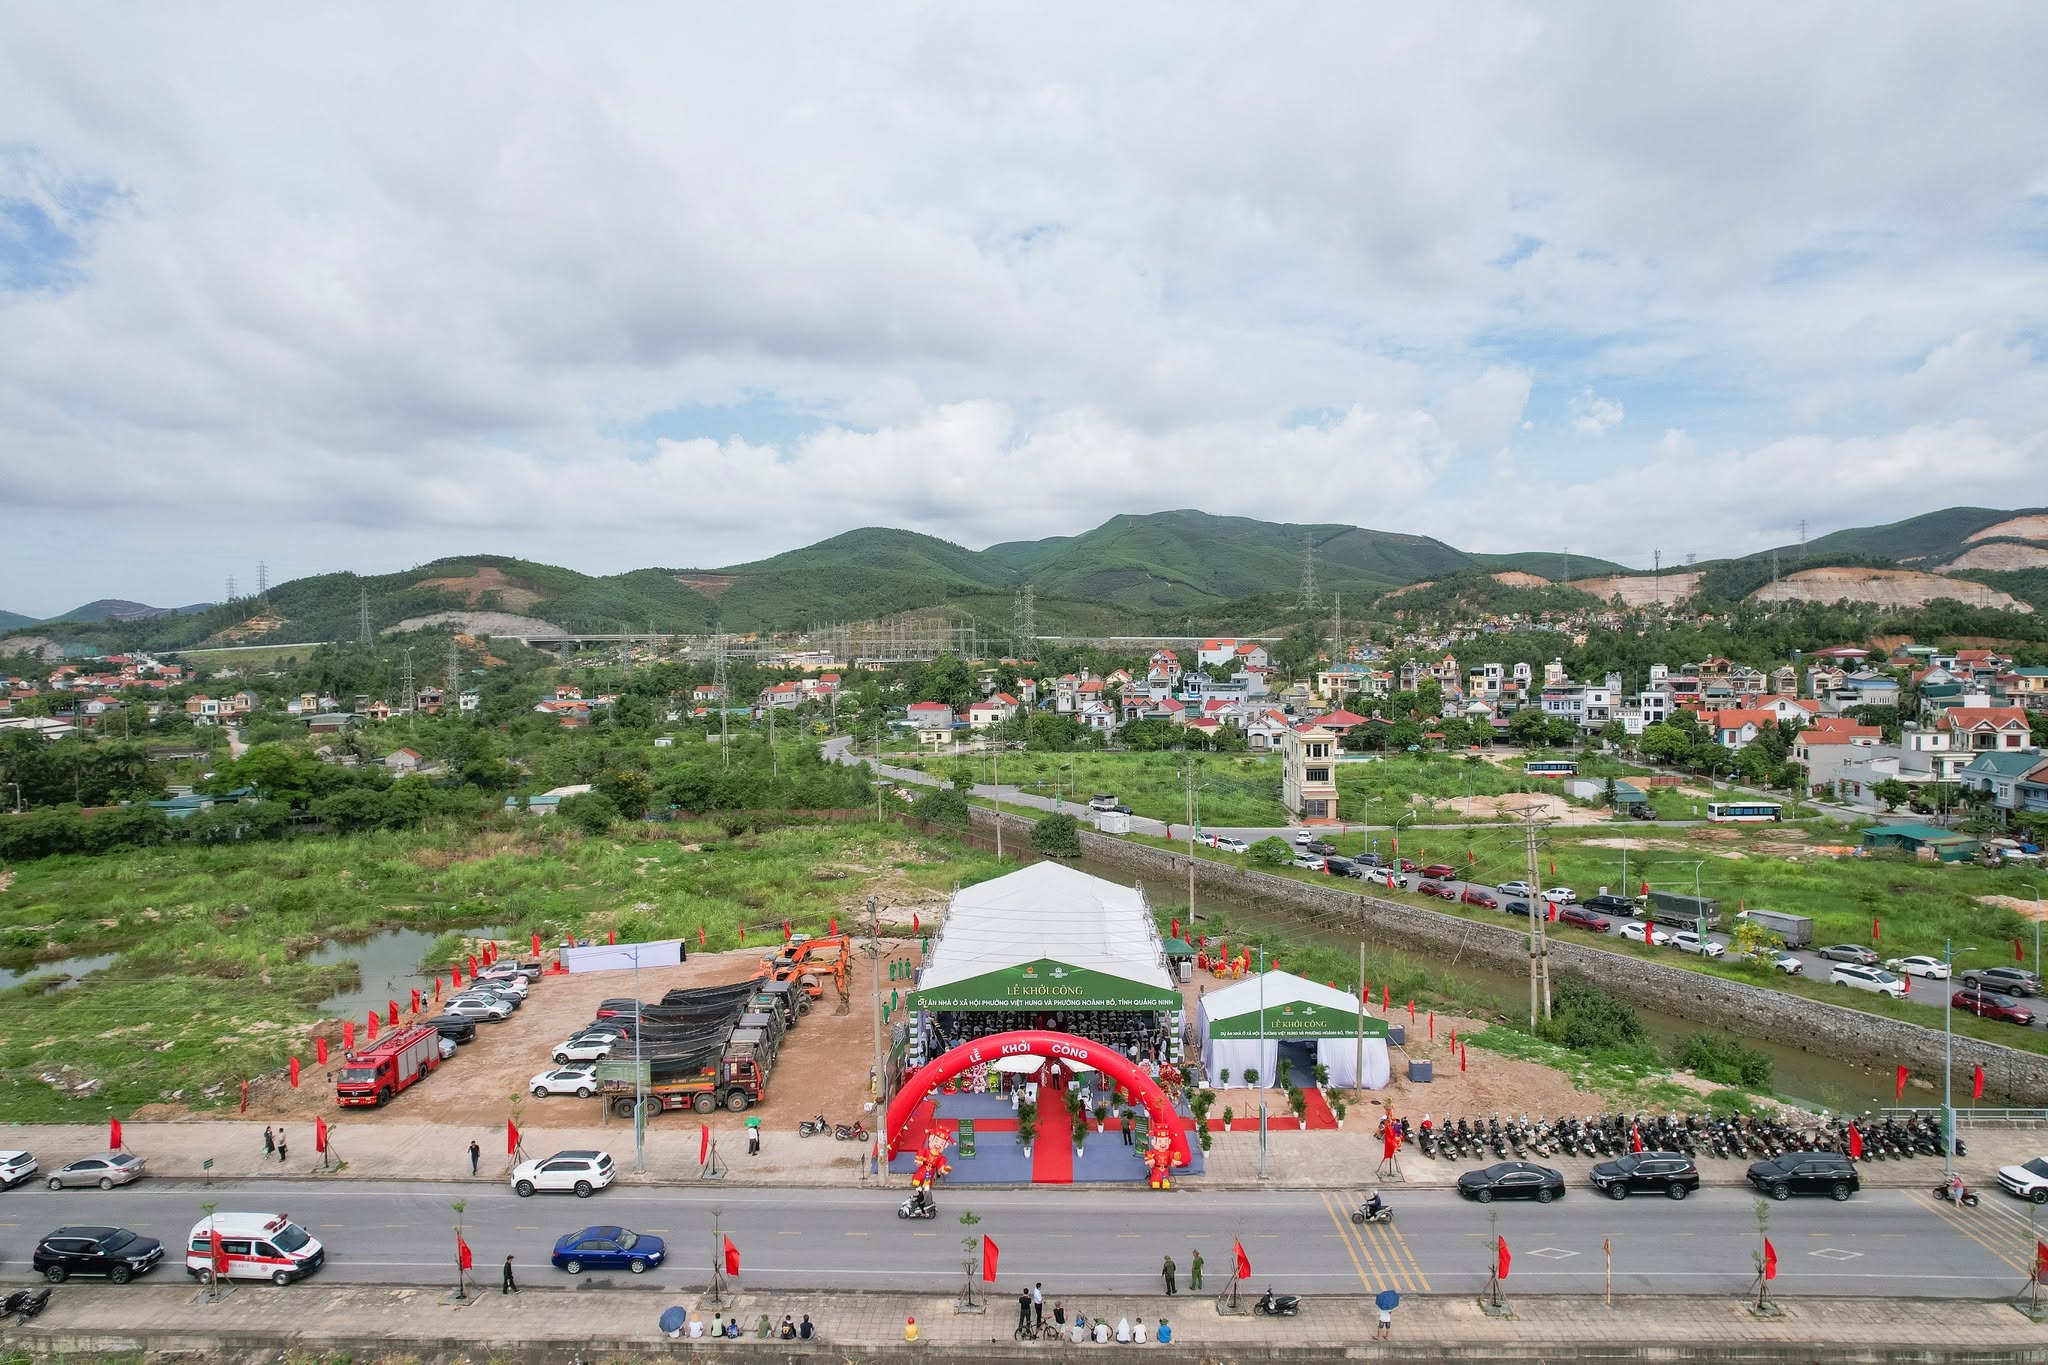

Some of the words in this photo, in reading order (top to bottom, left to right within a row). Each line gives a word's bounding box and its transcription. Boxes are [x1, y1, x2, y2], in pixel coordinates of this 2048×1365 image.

[1023, 984, 1049, 995] KHỞI
[1052, 985, 1083, 995] CÔNG
[938, 998, 952, 1006] NHÀ
[969, 999, 981, 1007] HỘI
[982, 998, 1008, 1006] PHƯỜNG
[1009, 999, 1023, 1007] VIỆT
[1043, 998, 1052, 1006] VÀ
[1053, 998, 1080, 1006] PHƯỜNG
[1082, 998, 1105, 1006] HOÀNH
[1118, 998, 1133, 1006] TỈNH
[1133, 998, 1157, 1006] QUẢNG
[1282, 1019, 1303, 1028] KHỞI
[1304, 1020, 1327, 1028] CÔNG
[969, 1048, 982, 1063] LỄ
[1001, 1040, 1031, 1054] KHỞI
[1051, 1043, 1088, 1059] CÔNG
